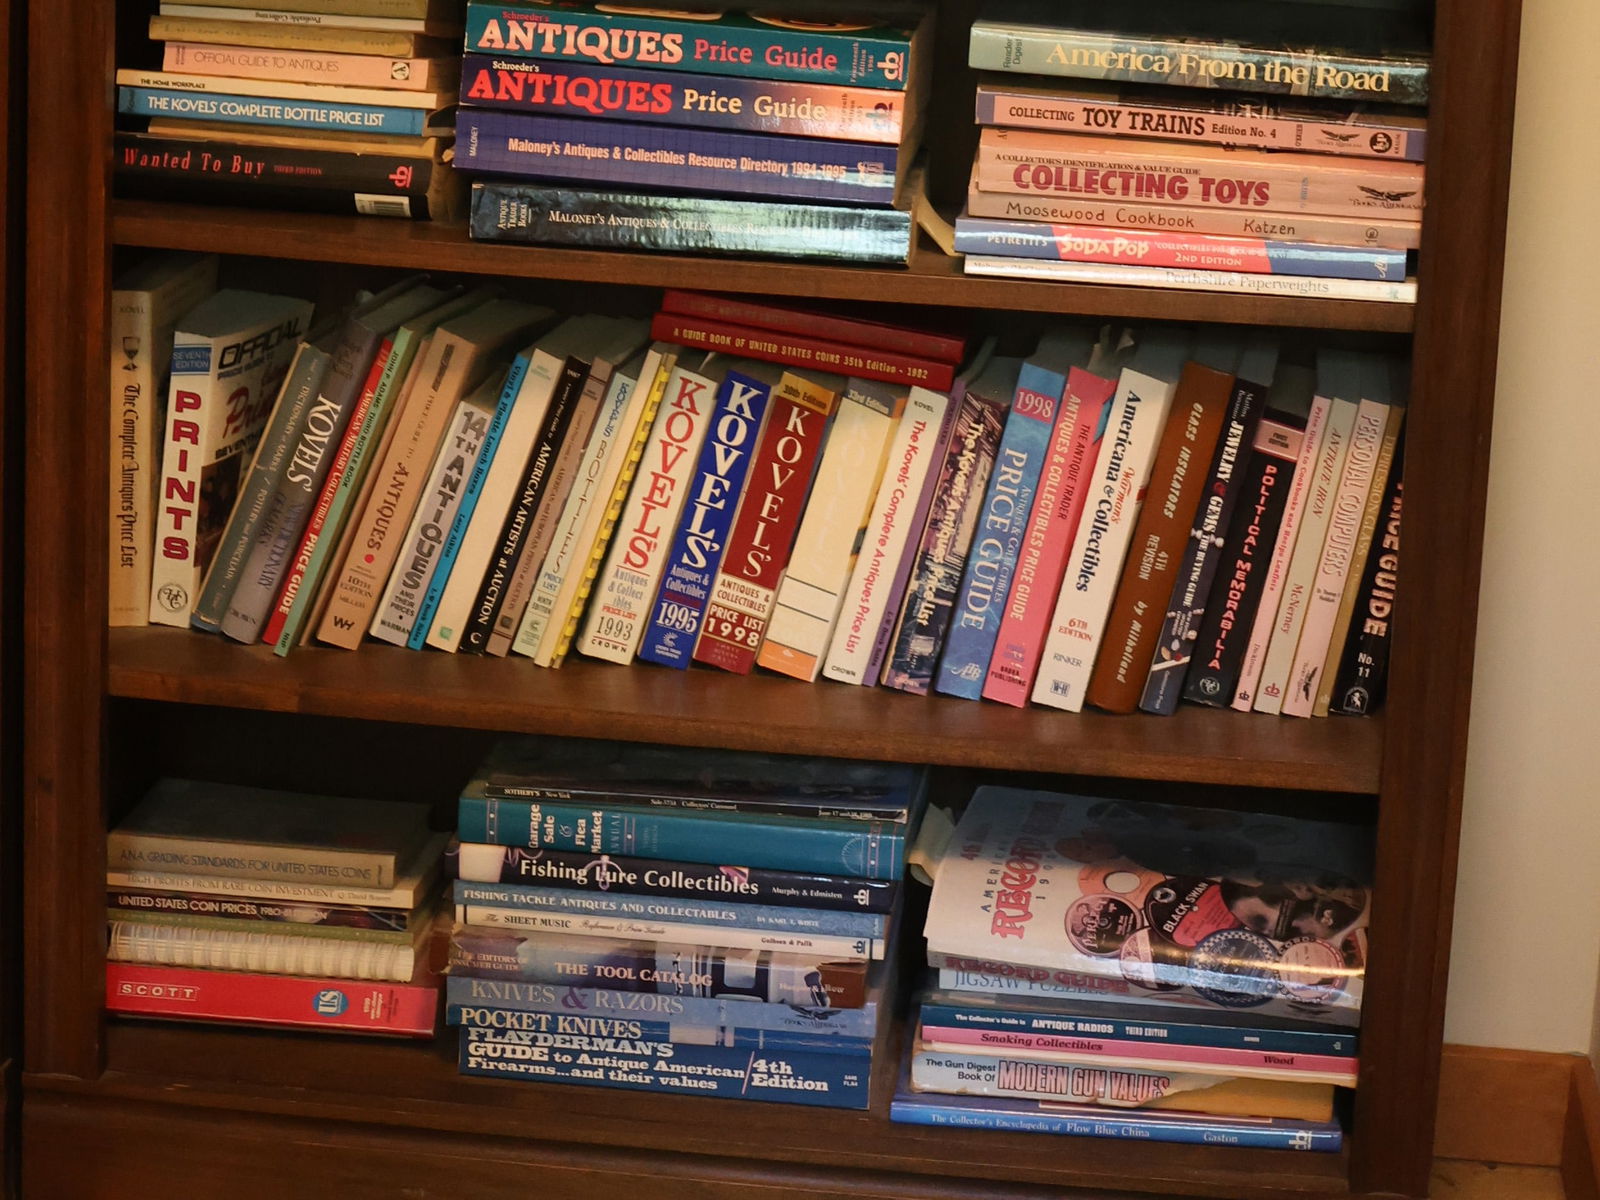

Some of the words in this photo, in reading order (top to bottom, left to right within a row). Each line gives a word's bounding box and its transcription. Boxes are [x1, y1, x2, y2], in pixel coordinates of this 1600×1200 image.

[478, 19, 683, 63] ANTIQUES
[694, 39, 752, 63] Price
[766, 45, 837, 71] Guide
[1047, 44, 1169, 73] America
[1178, 53, 1267, 82] From
[1273, 61, 1308, 84] the
[1315, 66, 1389, 92] Road
[148, 97, 170, 109] THE
[220, 103, 281, 118] COMPLETE
[284, 107, 327, 121] BOTTLE
[329, 111, 362, 123] PRICE
[364, 114, 384, 126] LIST
[1009, 106, 1075, 122] COLLECTING
[1083, 107, 1124, 128] TOY
[1128, 111, 1205, 136] TRAINS
[1211, 123, 1247, 137] Edition
[1250, 126, 1266, 138] No.
[1270, 128, 1277, 138] 4
[125, 148, 190, 170] Wanted
[202, 154, 221, 171] To
[232, 155, 264, 179] Buy
[1013, 164, 1188, 200] COLLECTING
[1200, 178, 1270, 206] TOYS
[1006, 202, 1105, 221] Moosewood
[1116, 209, 1195, 228] Cookbook
[1244, 219, 1295, 235] Katzen
[173, 352, 210, 360] SEVENTH
[674, 328, 680, 337] A
[683, 330, 705, 341] GUIDE
[710, 335, 731, 346] BOOK
[736, 338, 745, 348] OF
[749, 341, 777, 353] UNITED
[782, 345, 811, 359] STATES
[815, 350, 840, 364] COINS
[175, 359, 209, 368] EDITION
[1016, 390, 1054, 420] 1998
[1106, 391, 1141, 482] Americana
[162, 391, 202, 561] PRINTS
[521, 443, 552, 508] AMERICAN
[989, 447, 1028, 534] PRICE
[1102, 485, 1116, 495] &
[503, 506, 529, 556] ARTISTS
[1075, 495, 1111, 592] Collectibles
[478, 570, 505, 625] AUCTION
[961, 538, 1003, 630] GUIDE
[1358, 652, 1374, 667] No.
[1358, 667, 1369, 677] 11
[521, 860, 588, 883] Fishing
[595, 865, 638, 884] Lure
[644, 870, 759, 895] Collectibles
[122, 983, 195, 998] SCOTT
[468, 1027, 673, 1057] FLAYDERMAN'S
[468, 1043, 549, 1062] GUIDE
[553, 1052, 572, 1063] to
[577, 1052, 649, 1071] Antique
[653, 1060, 745, 1079] American
[752, 1060, 793, 1076] 4th
[609, 1071, 656, 1085] their
[660, 1075, 718, 1090] values
[752, 1074, 829, 1092] Edition
[998, 1061, 1068, 1094] MODERN
[1072, 1066, 1107, 1098] GUN
[1110, 1070, 1170, 1102] VALUES
